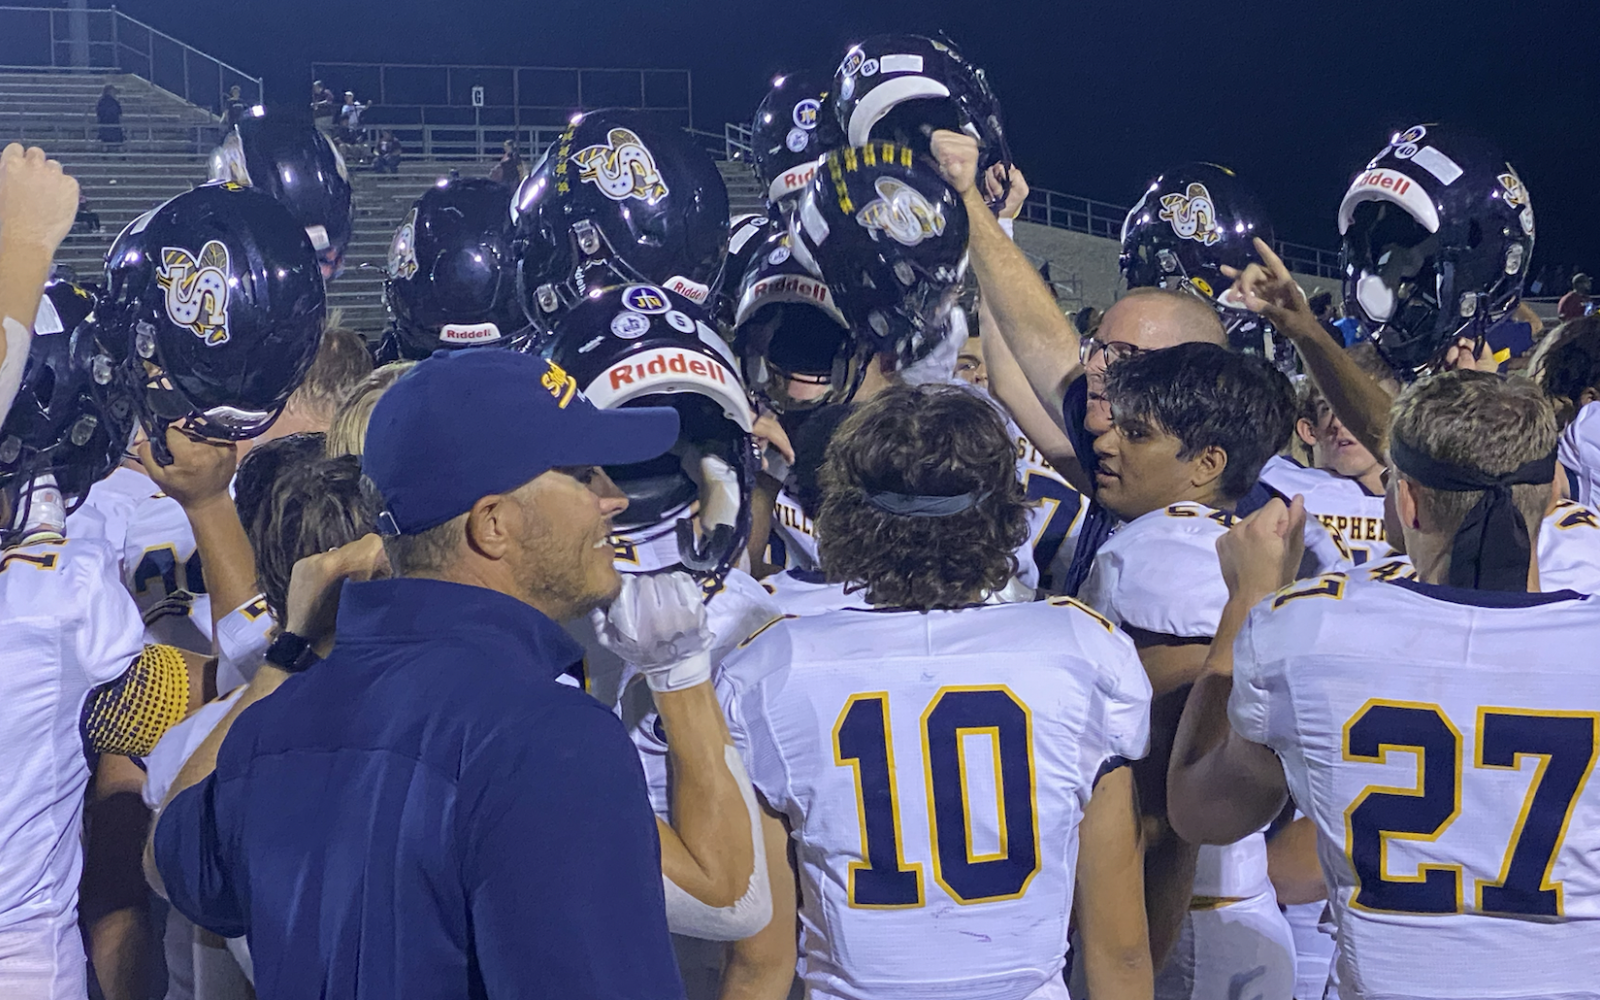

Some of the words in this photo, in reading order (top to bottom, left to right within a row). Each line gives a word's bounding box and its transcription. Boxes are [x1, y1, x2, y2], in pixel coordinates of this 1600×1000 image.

[474, 90, 482, 104] G
[754, 277, 827, 302] Riddell
[447, 329, 491, 339] Riddell
[608, 353, 727, 391] Riddell
[831, 684, 1042, 909] 10
[1342, 697, 1600, 918] 27
